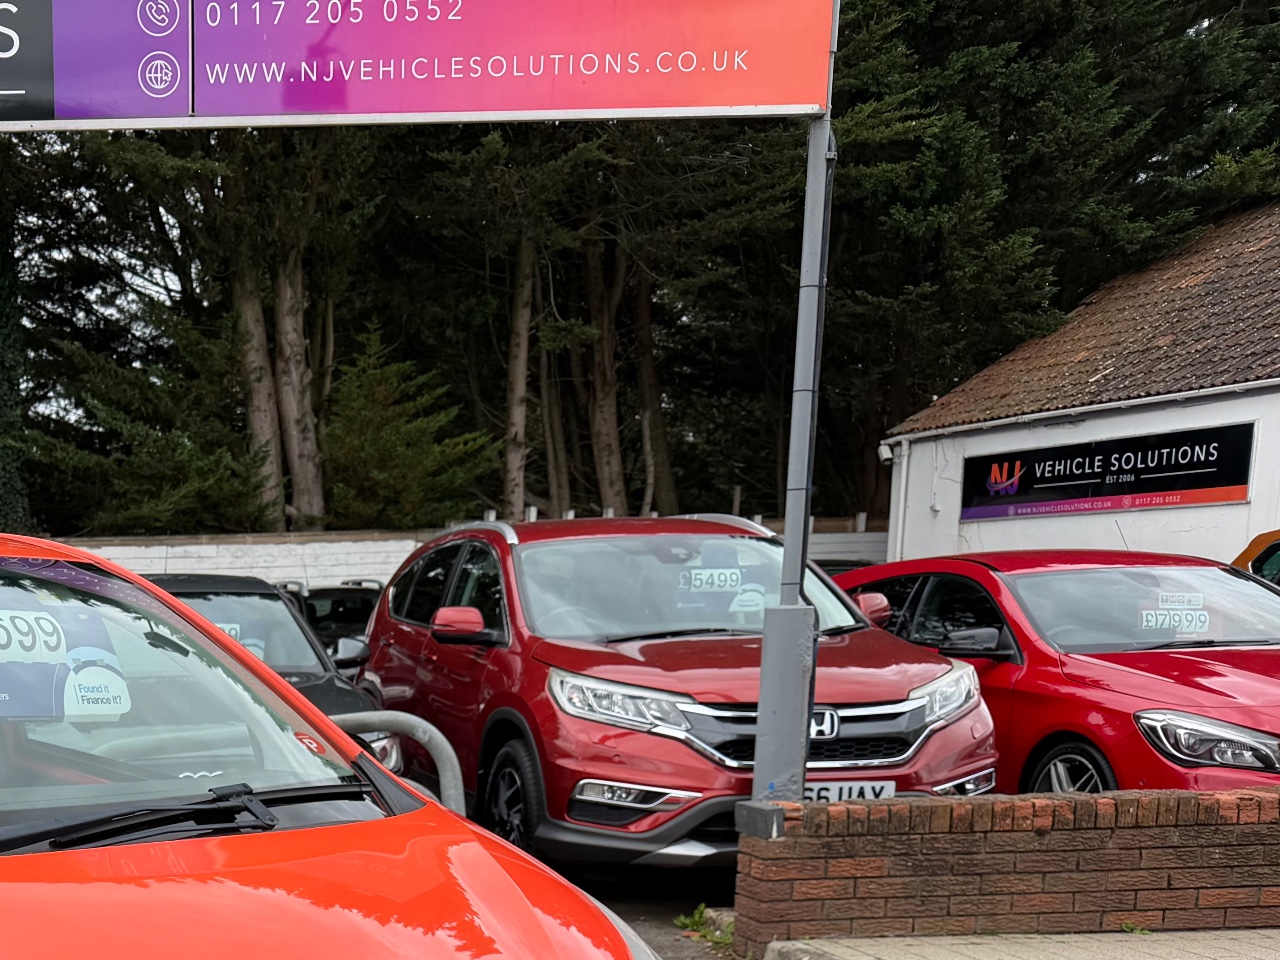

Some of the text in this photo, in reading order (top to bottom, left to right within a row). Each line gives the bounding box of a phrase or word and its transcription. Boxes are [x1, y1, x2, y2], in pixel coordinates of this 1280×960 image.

[205, 0, 463, 27] 0117 205 0552
[205, 49, 749, 85] WWW.NJVEHICLESOLUTIONS.CO.UK
[1035, 442, 1219, 478] VEHICLE SOLUTIONS
[1119, 473, 1135, 483] 2006
[1135, 495, 1181, 505] 0117 205 0552
[1017, 501, 1112, 513] WWW.NJVEHICLESOLUTIONS.CO.UK
[78, 684, 110, 693] Found it
[81, 695, 122, 705] Finance it?
